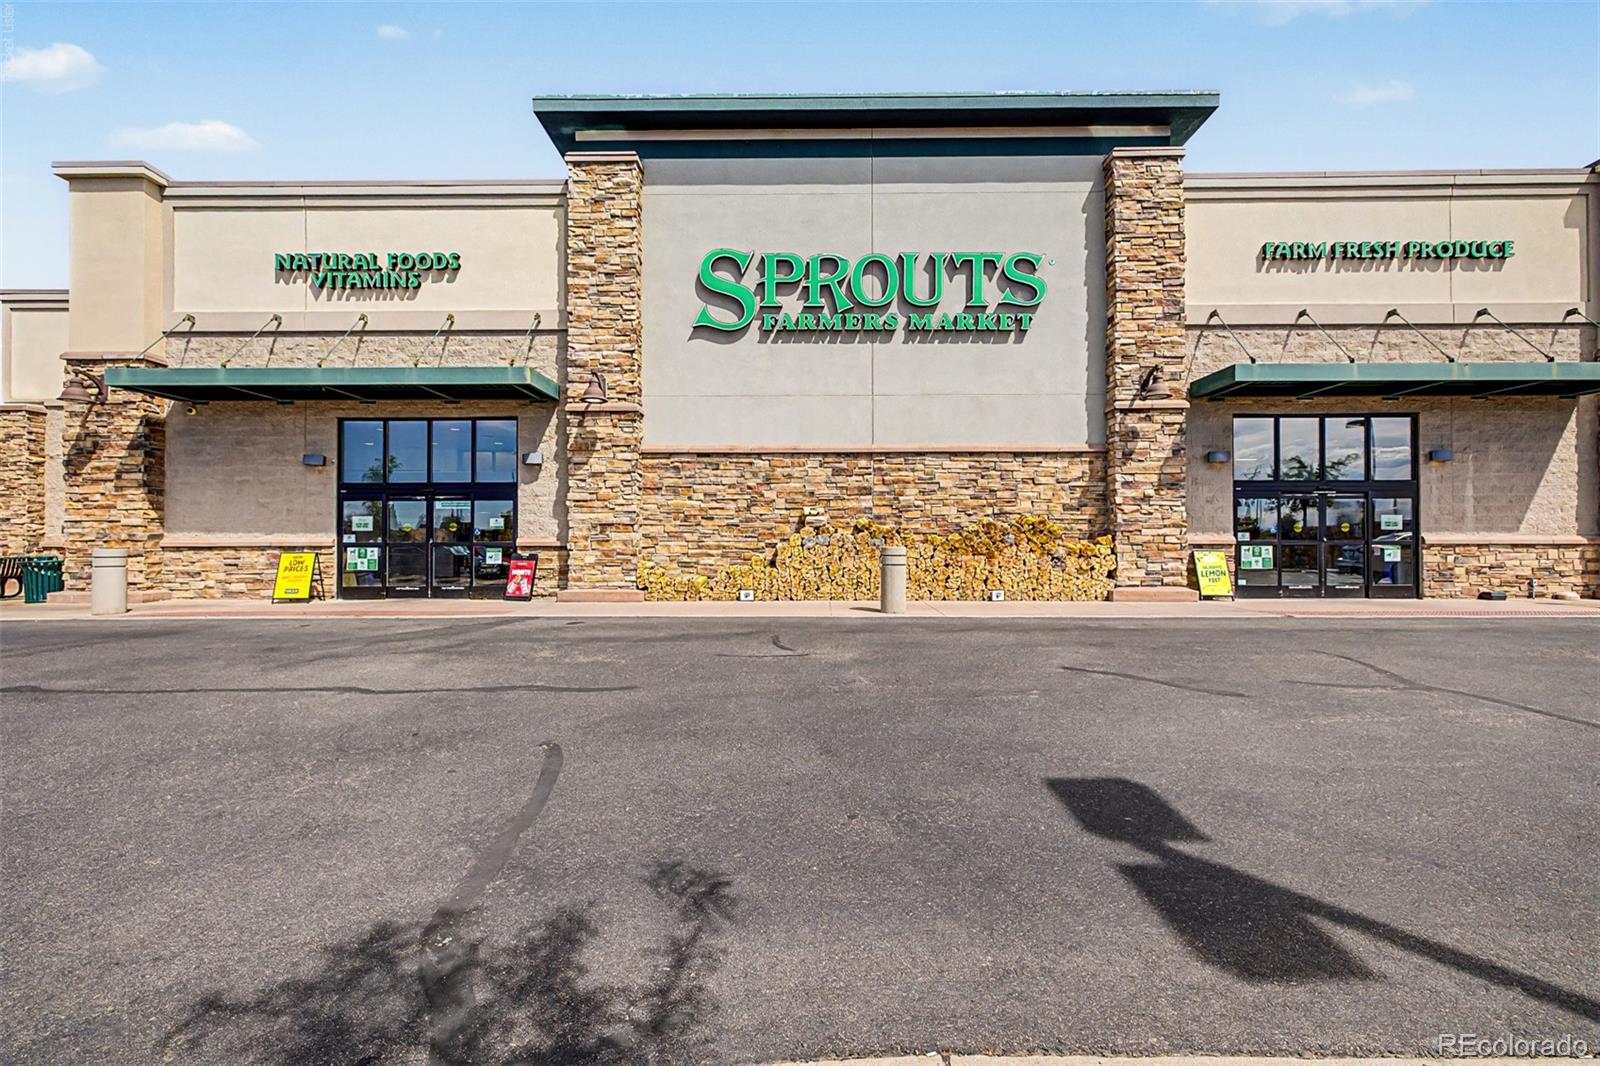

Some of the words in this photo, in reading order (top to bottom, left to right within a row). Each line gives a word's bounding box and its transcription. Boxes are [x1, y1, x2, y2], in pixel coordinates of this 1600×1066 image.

[1263, 240, 1328, 259] FARM
[1333, 240, 1401, 259] FRESH
[1407, 240, 1516, 258] PRODUCE
[274, 252, 380, 271] NATURAL
[387, 252, 461, 271] FOODS
[310, 271, 422, 289] VITAMINS
[692, 248, 1048, 332] SPROUTS
[762, 312, 900, 332] FARMERS
[909, 312, 1033, 332] MARKET
[1201, 569, 1227, 577] LEMON
